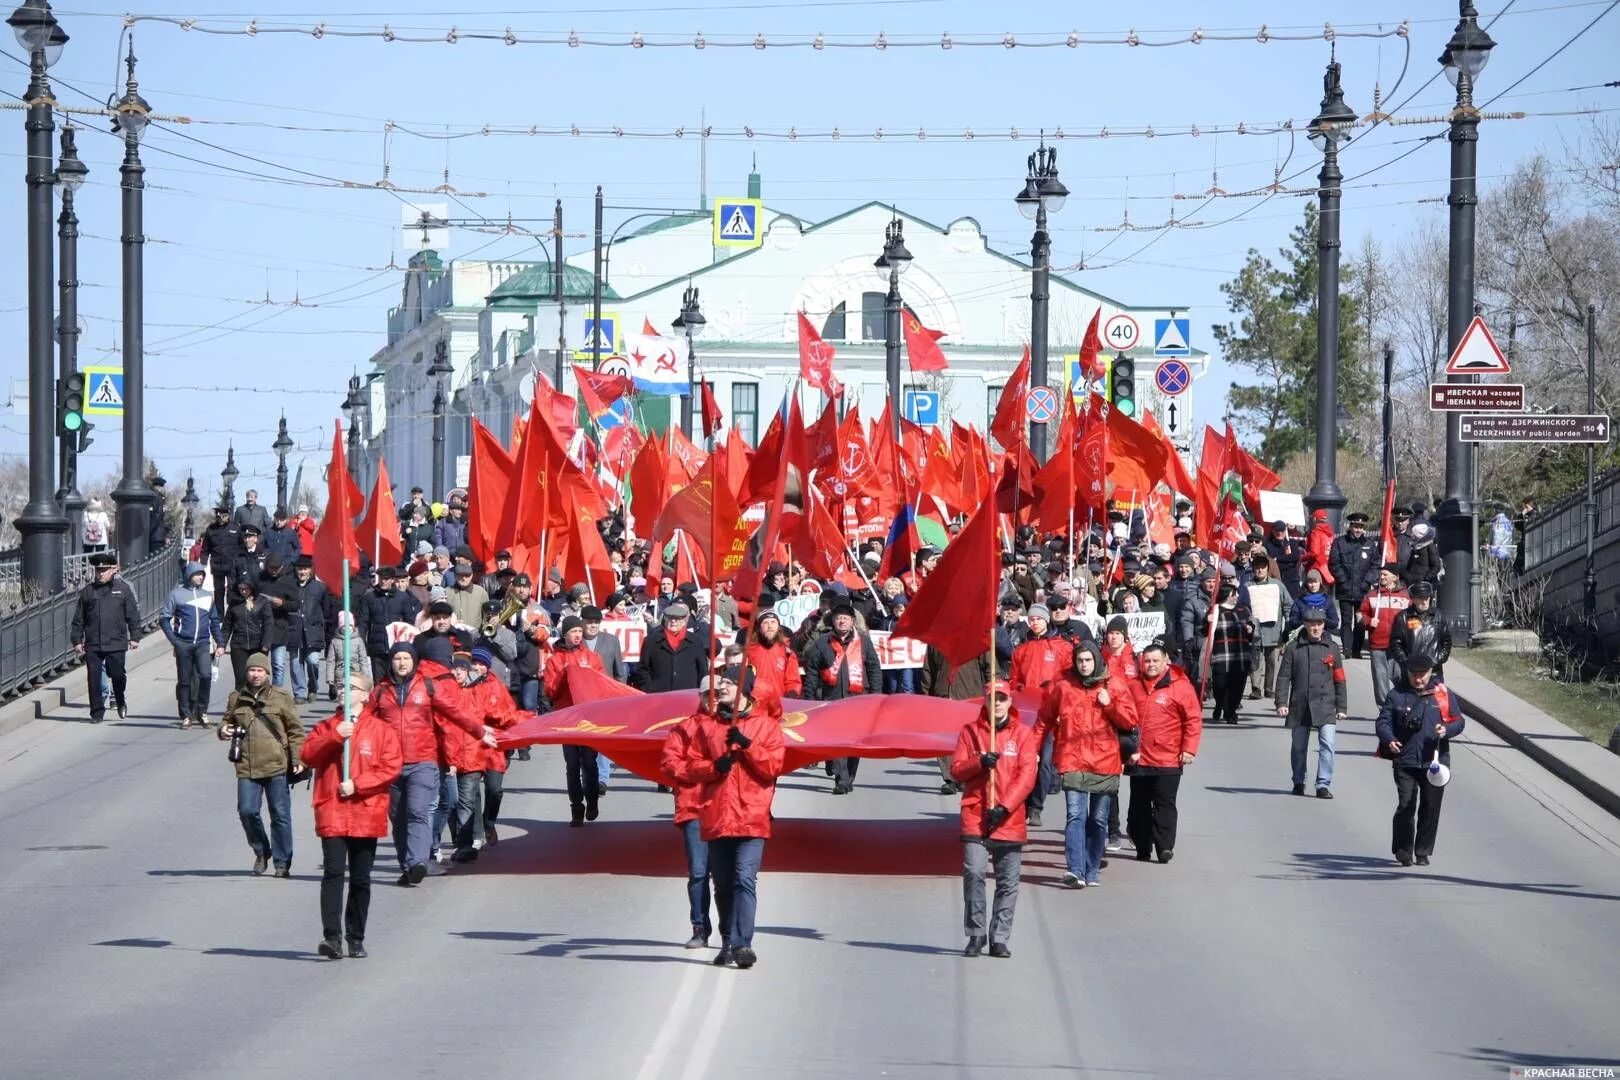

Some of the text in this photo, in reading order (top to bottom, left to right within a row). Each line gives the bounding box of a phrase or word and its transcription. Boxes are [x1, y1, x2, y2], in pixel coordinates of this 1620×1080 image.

[1111, 324, 1133, 340] 40
[1446, 389, 1488, 397] ИВЕРСКАЯ
[1446, 398, 1477, 406] IBERIAN
[1496, 399, 1520, 407] chapel
[1511, 418, 1576, 427] ДЗЕРЖИНСКОГО
[1473, 429, 1527, 437] DZERZHINSKY
[1529, 430, 1552, 438] public
